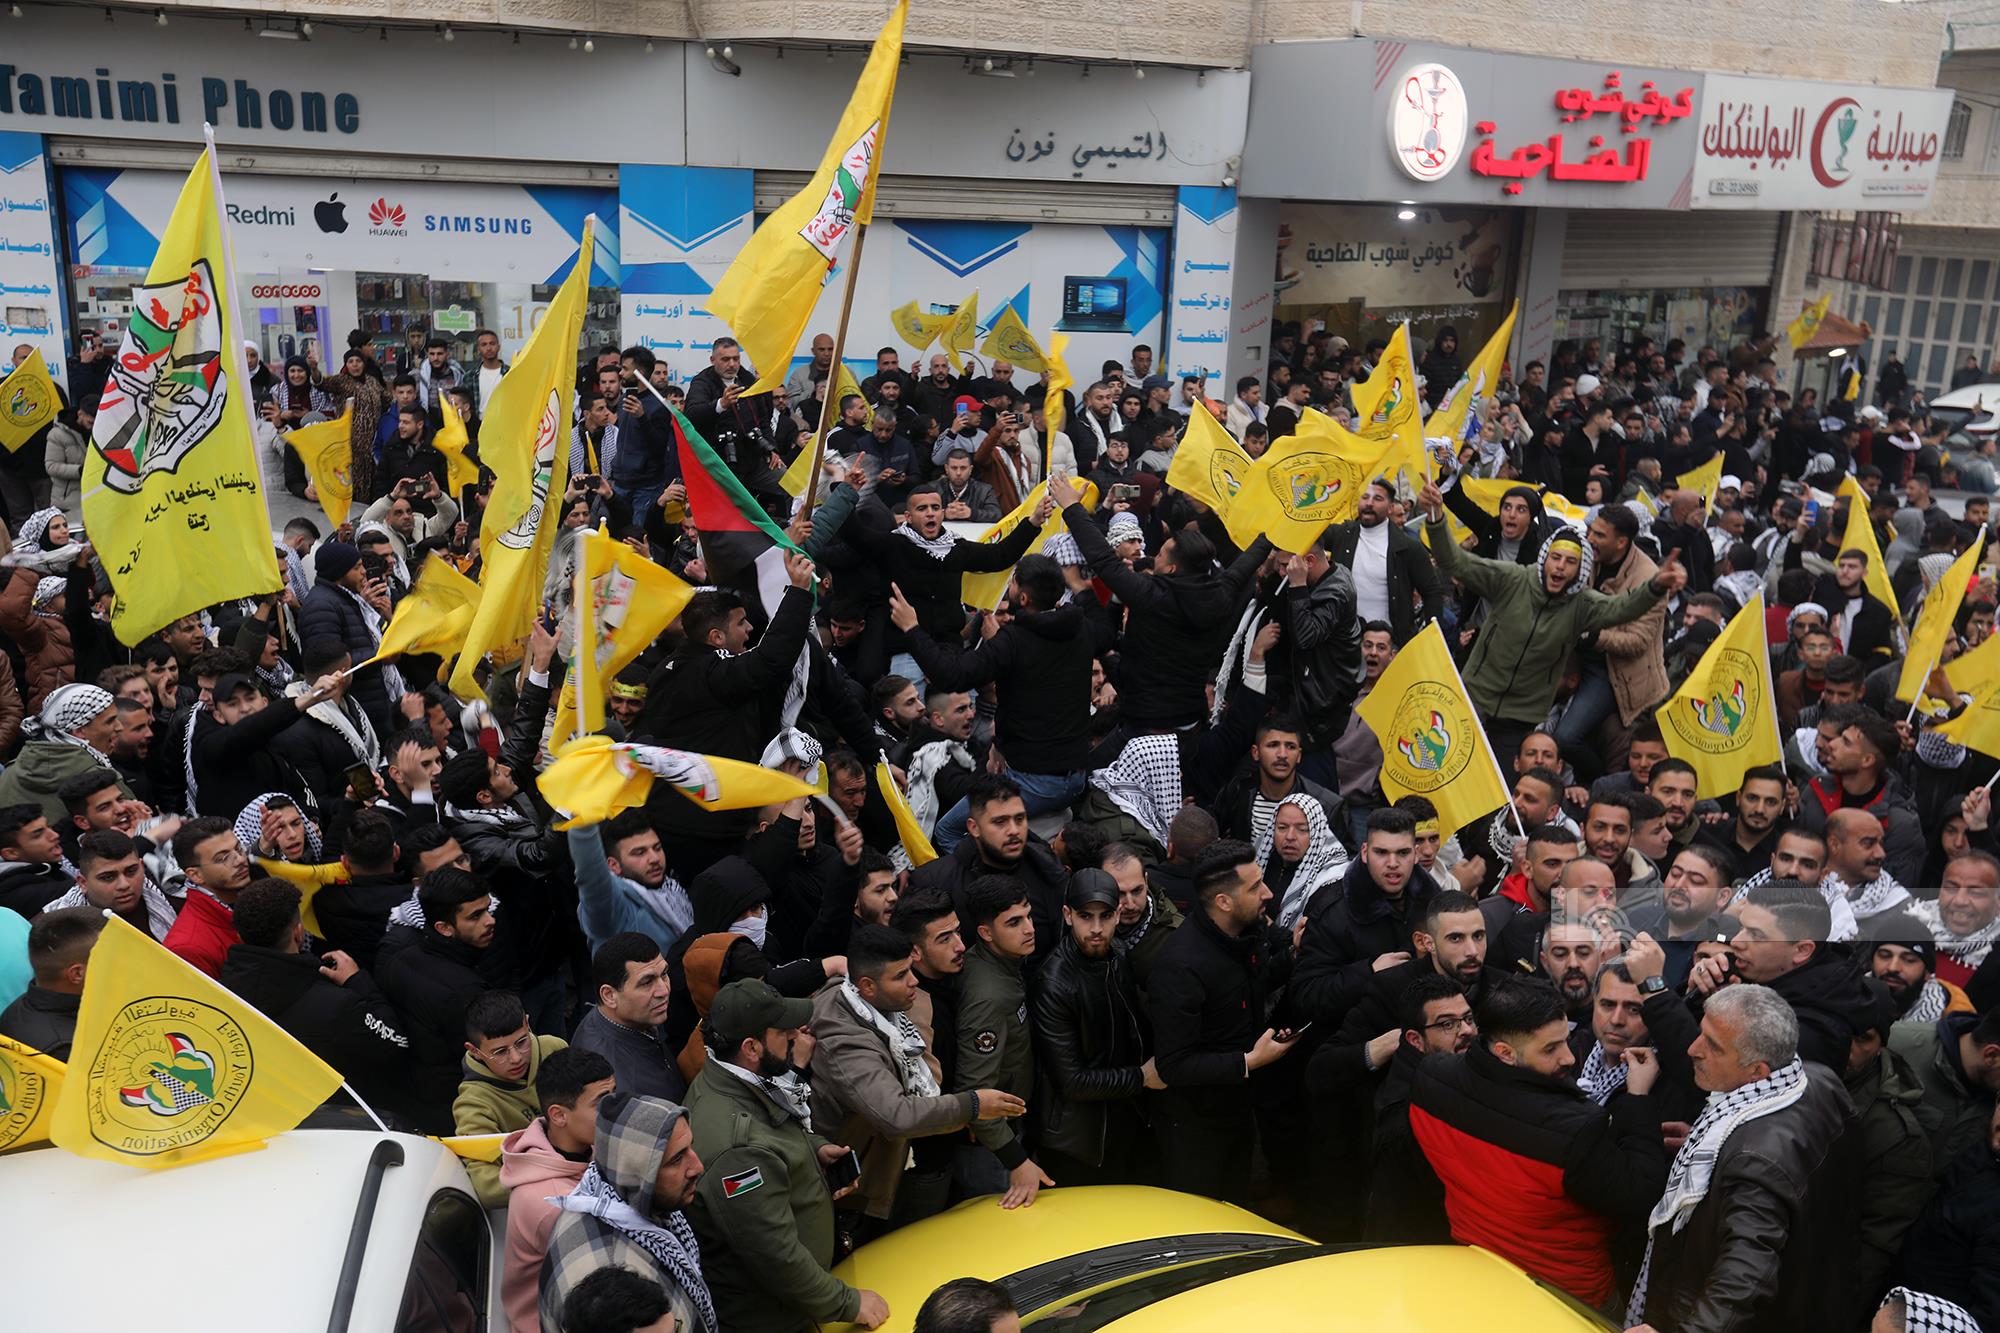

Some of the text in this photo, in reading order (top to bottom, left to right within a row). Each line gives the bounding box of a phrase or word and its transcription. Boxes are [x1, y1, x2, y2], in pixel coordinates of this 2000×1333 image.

[0, 64, 360, 134] Tamimi Phone
[1555, 72, 1694, 133] كوفي شوب
[1866, 110, 1938, 172] صيدلية
[1006, 128, 1167, 178] التميمي فون
[1471, 122, 1651, 195] الضاحية
[225, 205, 296, 227] Redmi
[424, 214, 533, 236] SAMSUNG
[369, 228, 407, 237] HUAWEI
[1306, 238, 1453, 272] كوفي شوب الضاحية
[1184, 260, 1230, 274] بيع
[251, 285, 321, 299] ooredoo
[1179, 293, 1230, 310] وتركيب
[636, 299, 683, 318] أوريدو
[1177, 326, 1229, 343] أنظمة
[1177, 364, 1222, 379] ماقبة
